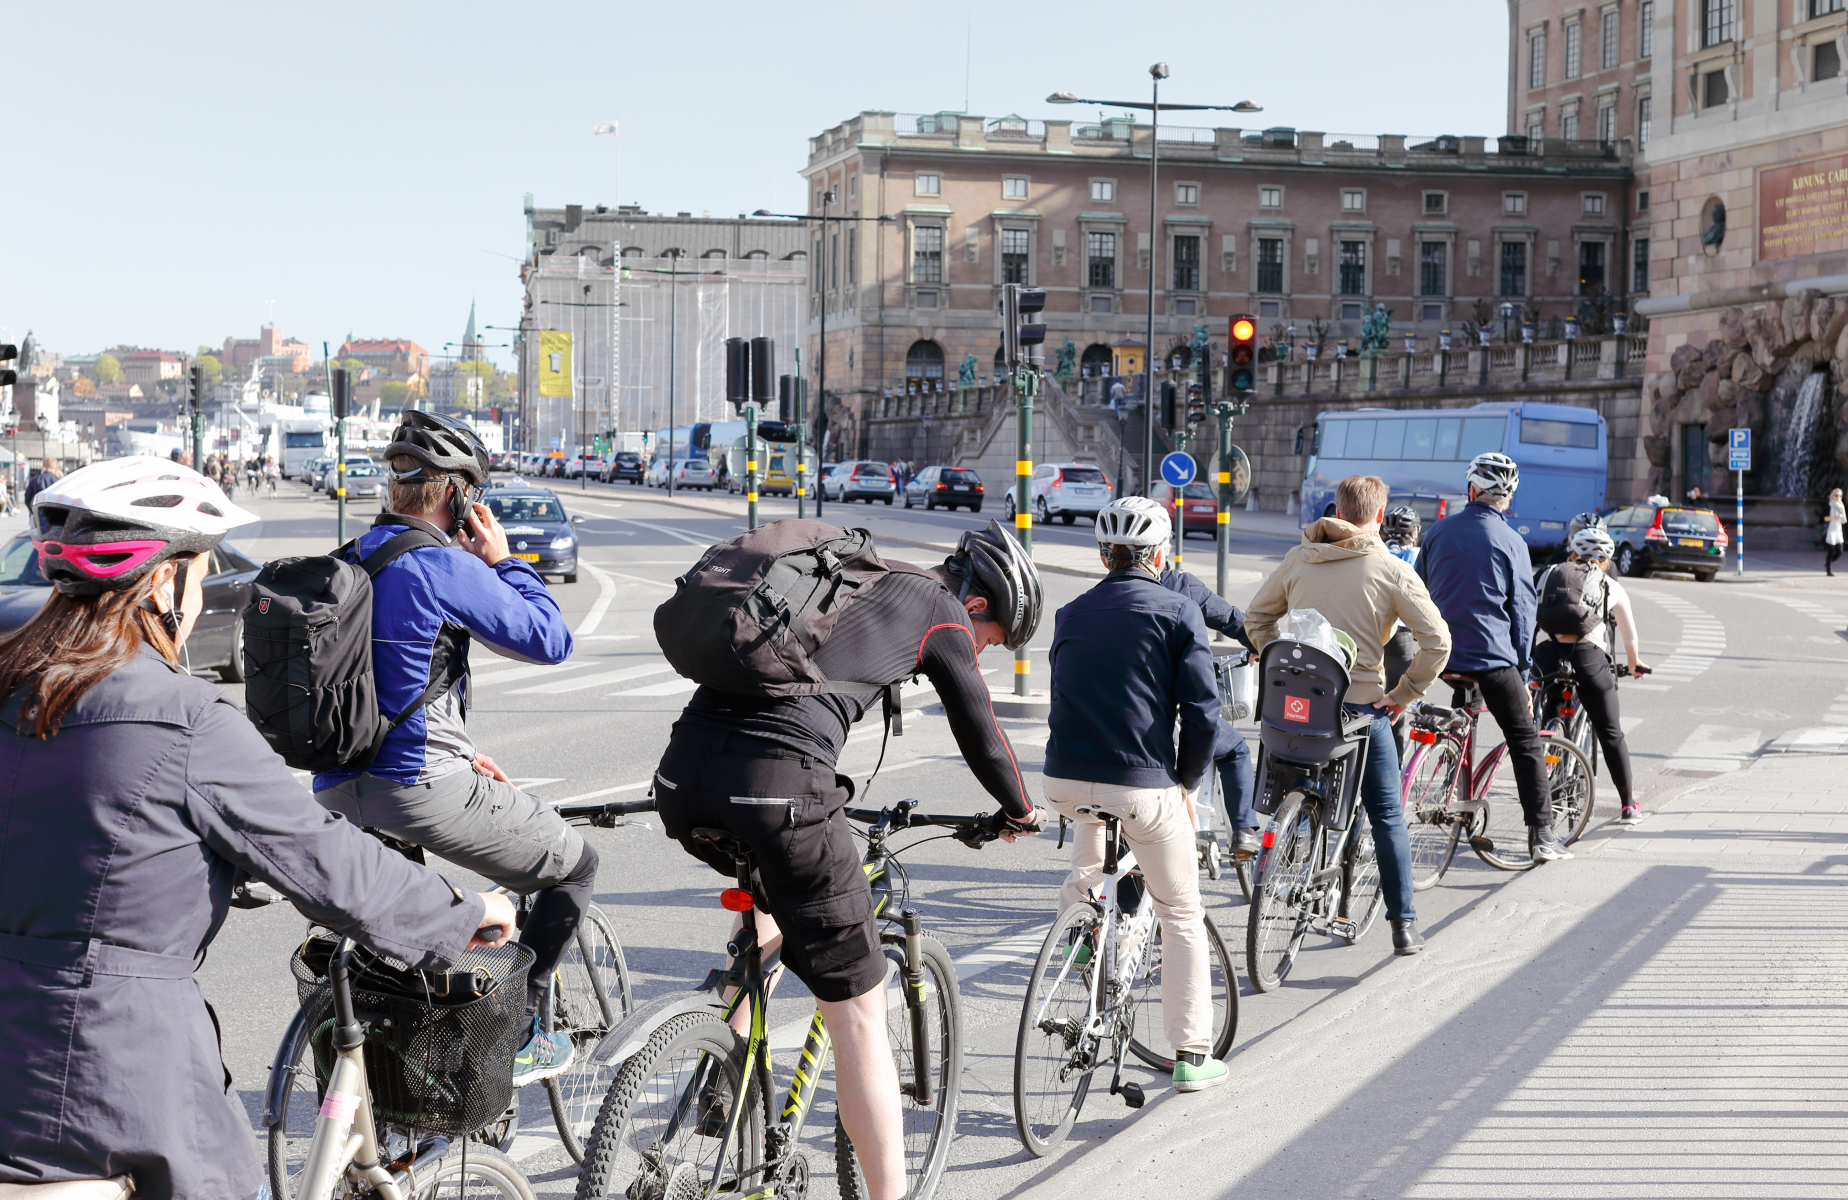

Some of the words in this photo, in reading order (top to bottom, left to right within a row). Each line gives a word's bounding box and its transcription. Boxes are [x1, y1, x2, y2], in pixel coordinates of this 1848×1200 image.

[1793, 172, 1825, 190] KONUNG
[1734, 431, 1746, 447] P
[710, 565, 732, 575] TIGHT
[1286, 711, 1307, 720] hamax
